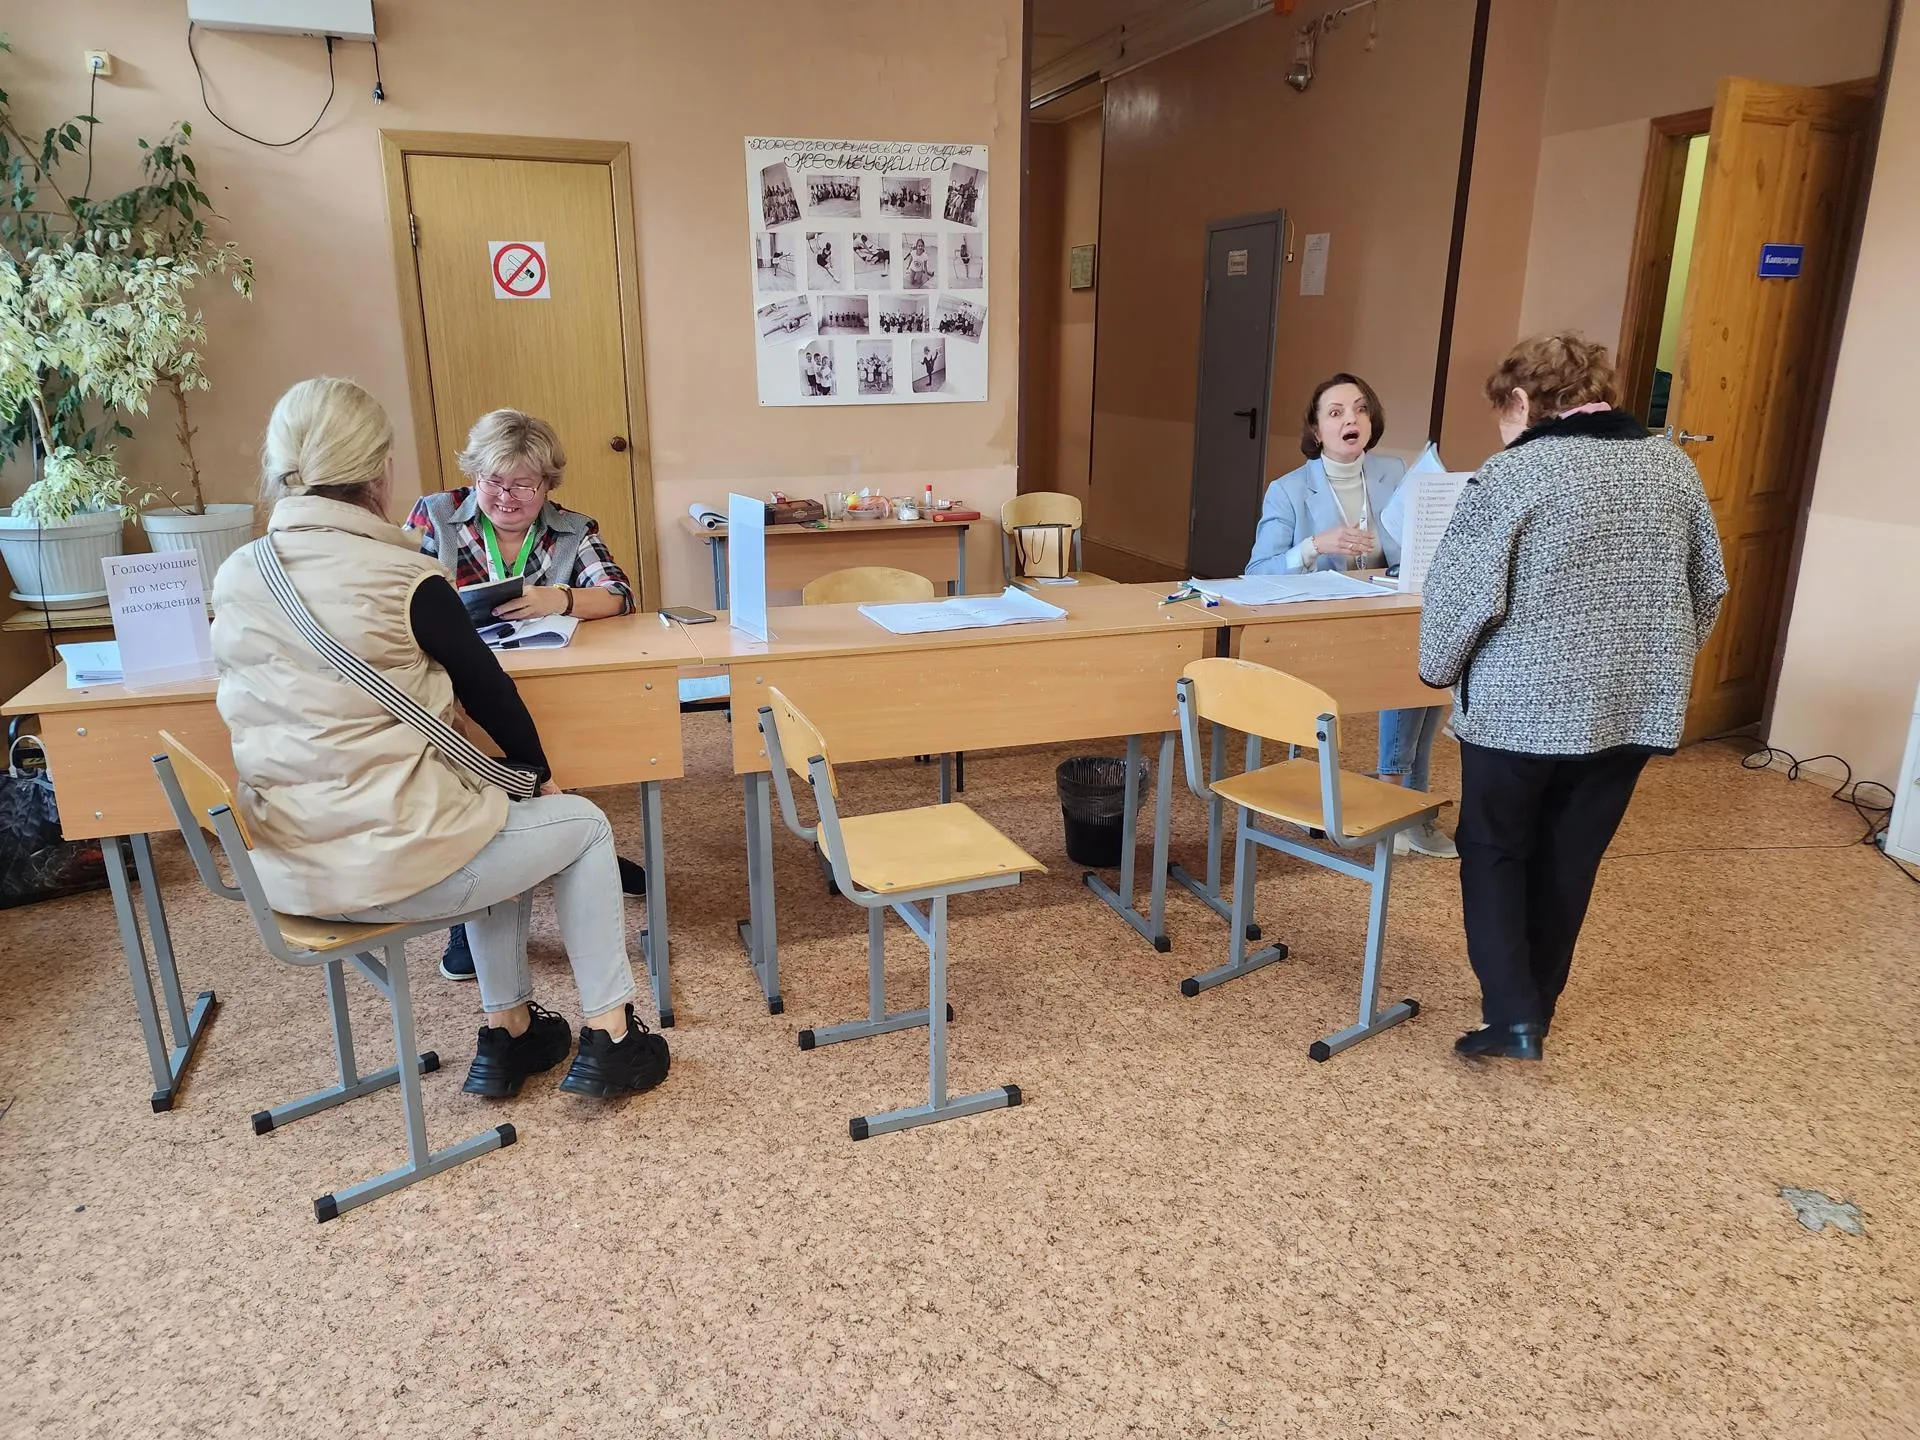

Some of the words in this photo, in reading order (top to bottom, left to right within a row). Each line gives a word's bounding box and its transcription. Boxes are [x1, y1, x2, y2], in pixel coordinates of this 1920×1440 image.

[111, 558, 198, 576] Голосующие
[129, 585, 146, 595] по
[150, 579, 187, 593] месту
[121, 597, 201, 615] нахождения
